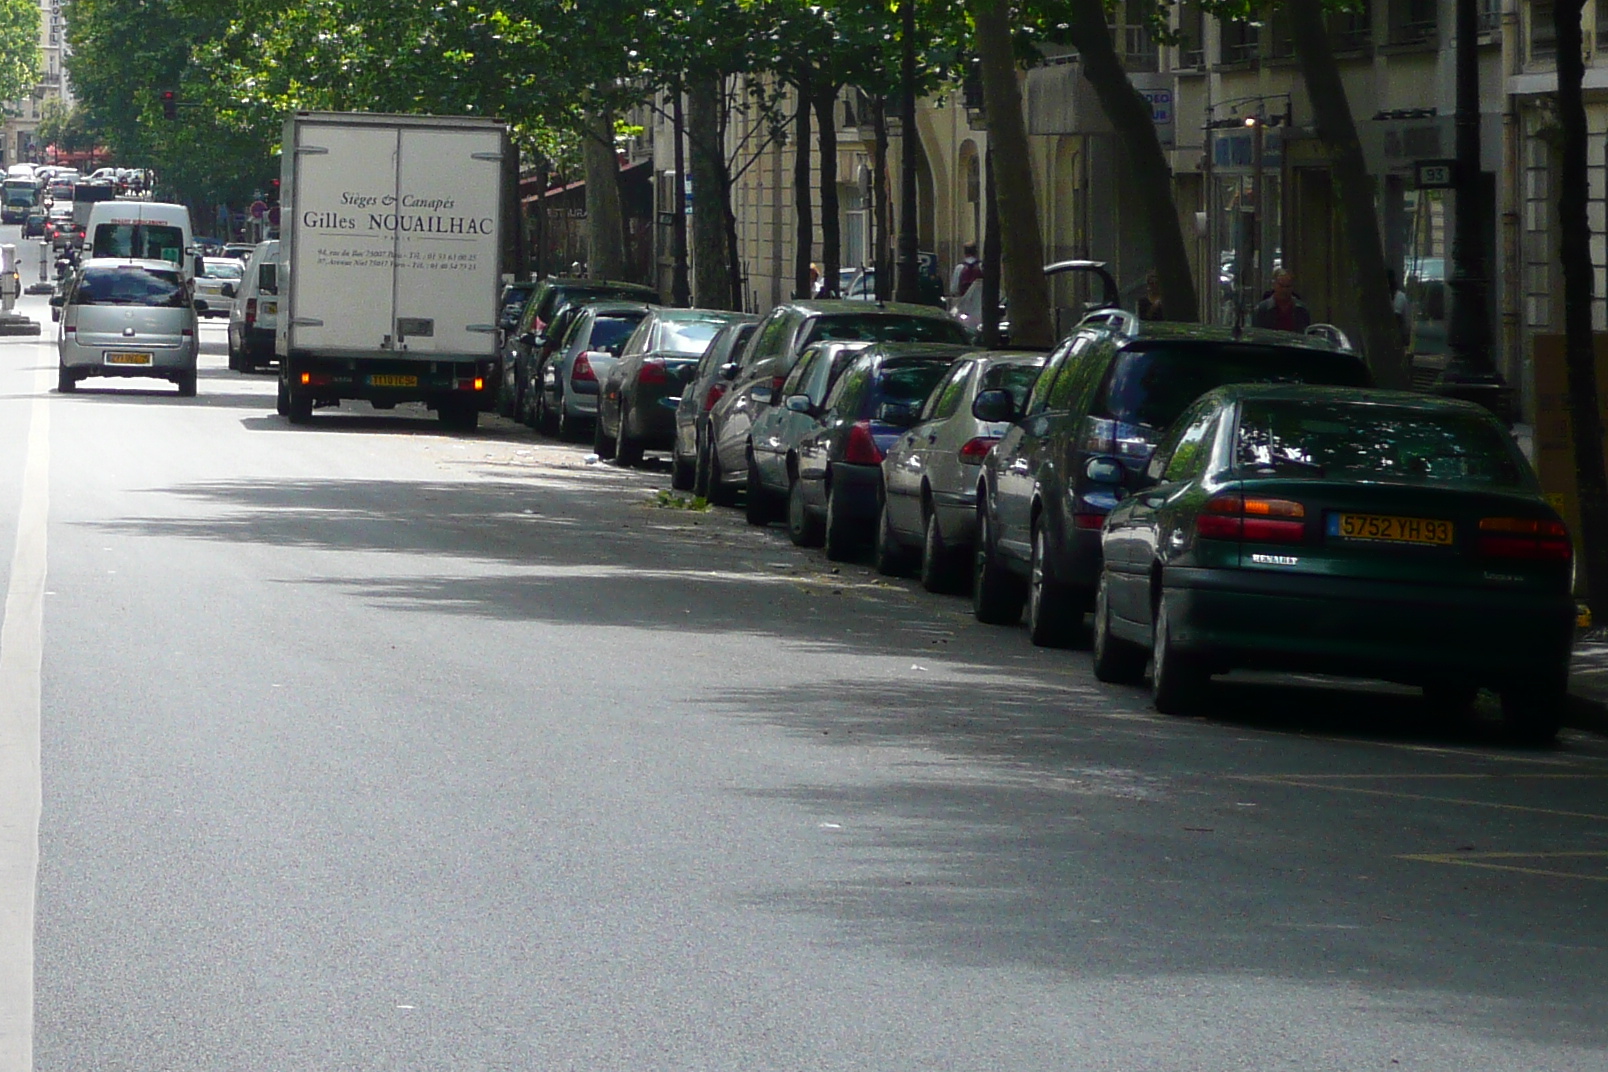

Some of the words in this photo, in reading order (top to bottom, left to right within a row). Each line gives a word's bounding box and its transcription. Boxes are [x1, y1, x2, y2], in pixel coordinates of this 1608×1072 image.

[1425, 167, 1444, 182] 93
[340, 191, 377, 209] Sièges
[381, 194, 398, 206] &
[402, 194, 455, 212] Canapés
[303, 211, 356, 229] Gilles
[368, 213, 494, 235] NOUAILHAC
[1342, 513, 1393, 539] 5752
[1397, 518, 1421, 540] YH
[1424, 520, 1448, 543] 93
[1252, 552, 1299, 567] RENAULT
